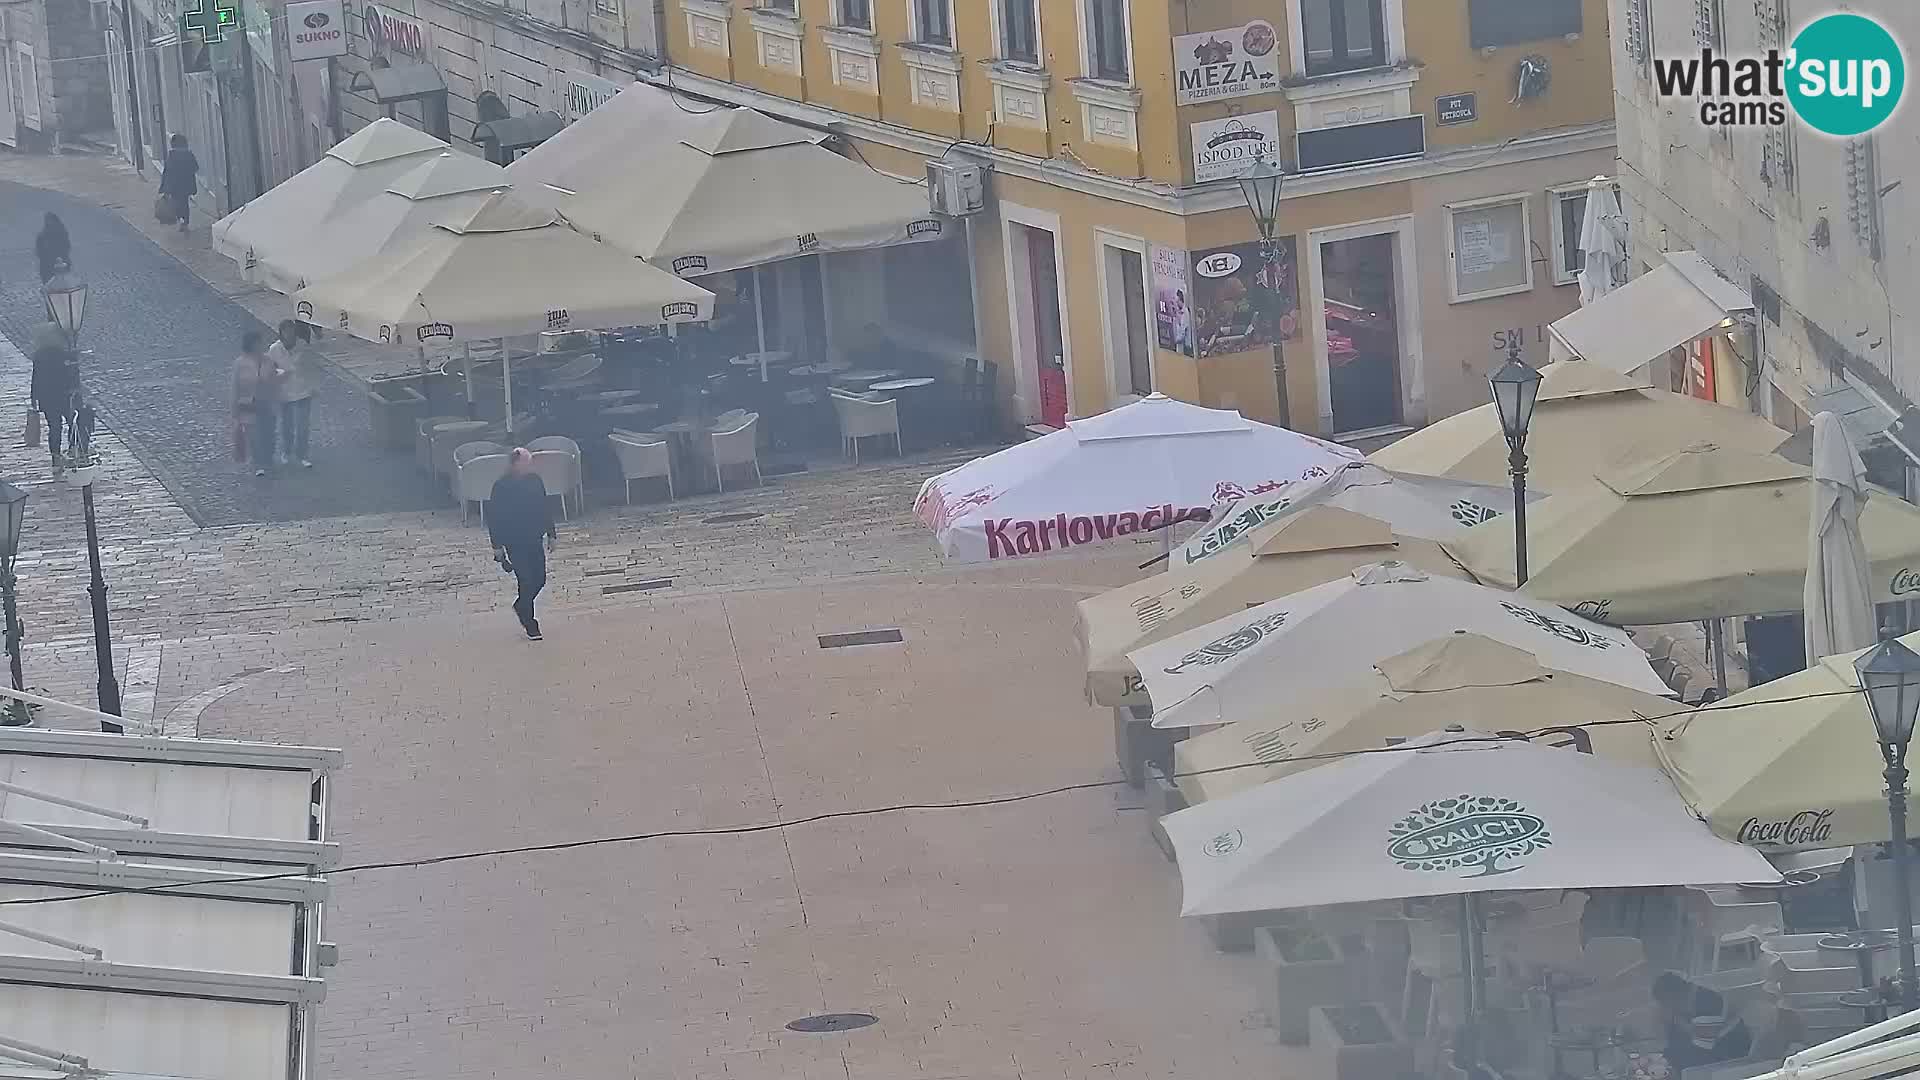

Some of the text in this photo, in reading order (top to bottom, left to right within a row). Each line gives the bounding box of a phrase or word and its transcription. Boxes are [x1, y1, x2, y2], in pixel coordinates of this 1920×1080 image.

[296, 30, 340, 43] SUKNO
[382, 15, 421, 49] SUKNO
[1179, 60, 1258, 91] MEZA
[1188, 83, 1249, 98] PIZZERIA & GRILL
[1450, 100, 1461, 108] PUT
[1441, 109, 1472, 120] PETROVCA
[1197, 141, 1276, 165] ISPOD URE
[1427, 818, 1526, 850] RAUCH
